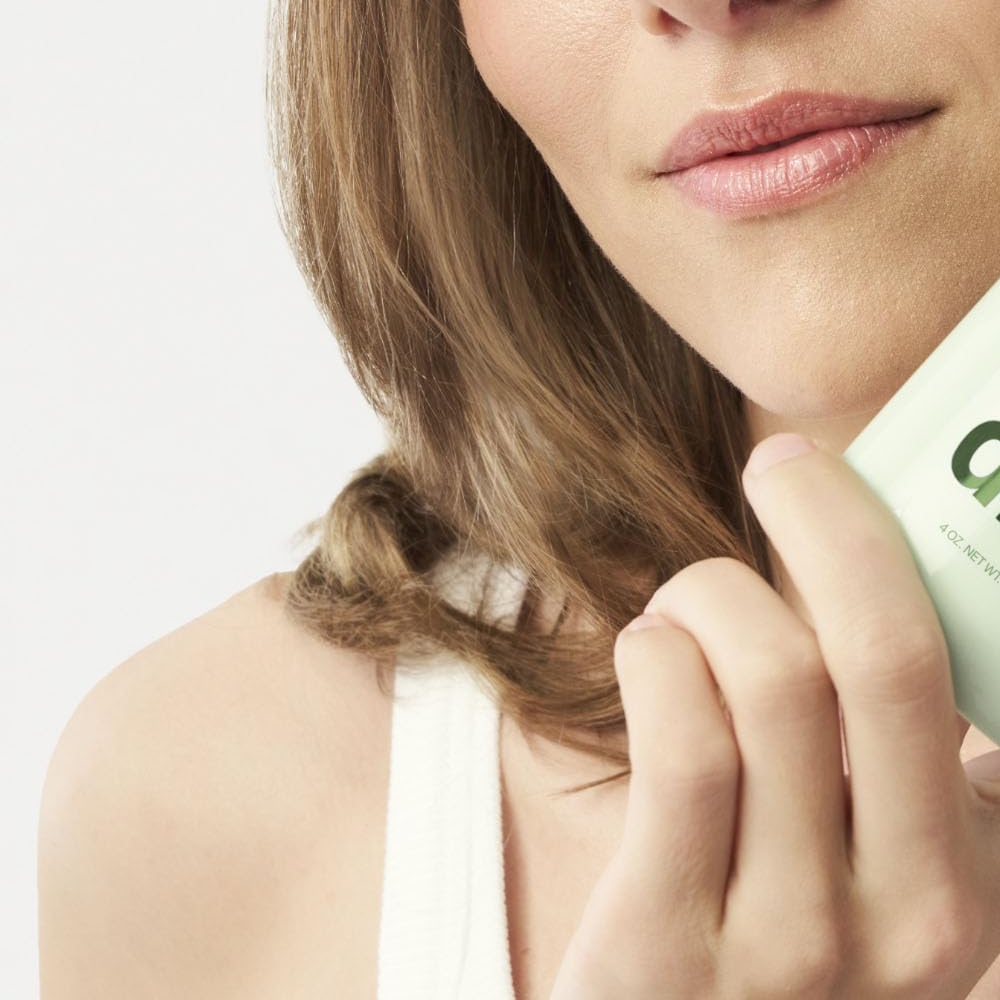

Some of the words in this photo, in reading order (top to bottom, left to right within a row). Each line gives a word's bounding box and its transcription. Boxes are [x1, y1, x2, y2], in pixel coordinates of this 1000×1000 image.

[939, 523, 949, 533] 4
[947, 529, 964, 549] OZ.
[963, 544, 987, 566] NET
